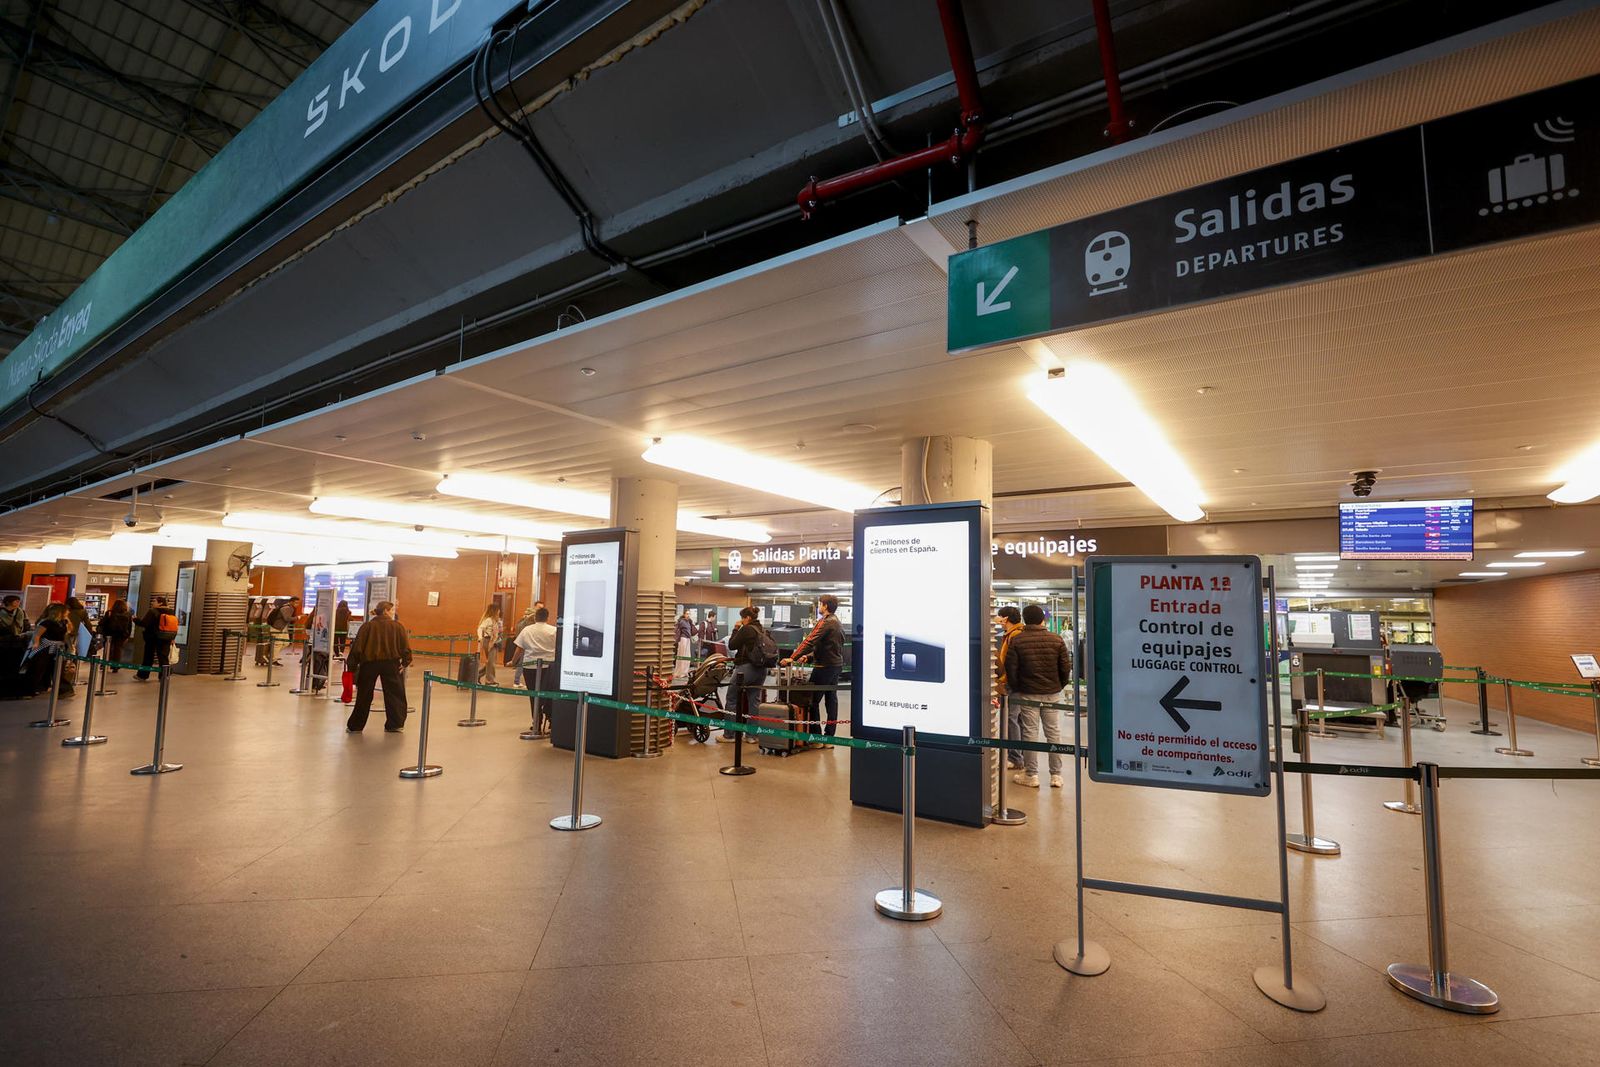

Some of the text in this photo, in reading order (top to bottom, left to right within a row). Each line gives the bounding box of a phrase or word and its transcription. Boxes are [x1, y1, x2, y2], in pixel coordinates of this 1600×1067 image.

[1174, 174, 1355, 243] Salidas
[1176, 223, 1344, 277] DEPARTURES
[880, 538, 910, 546] millones
[1005, 535, 1097, 558] equipajes
[752, 549, 794, 562] Salidas
[800, 547, 840, 560] Planta
[870, 547, 898, 555] clientes
[752, 567, 792, 575] DEPARTURES
[794, 566, 816, 574] FLOOR
[1140, 575, 1204, 590] PLANTA
[1150, 598, 1221, 615] Entrada
[1139, 619, 1234, 637] Control de
[1142, 641, 1232, 660] equipajes
[1131, 659, 1243, 674] LUGGAGE CONTROL
[889, 702, 919, 710] REPUBLIC
[1118, 730, 1257, 751] No está permitido el acceso
[1141, 746, 1235, 764] de acompañantes.
[1226, 769, 1253, 778] adif
